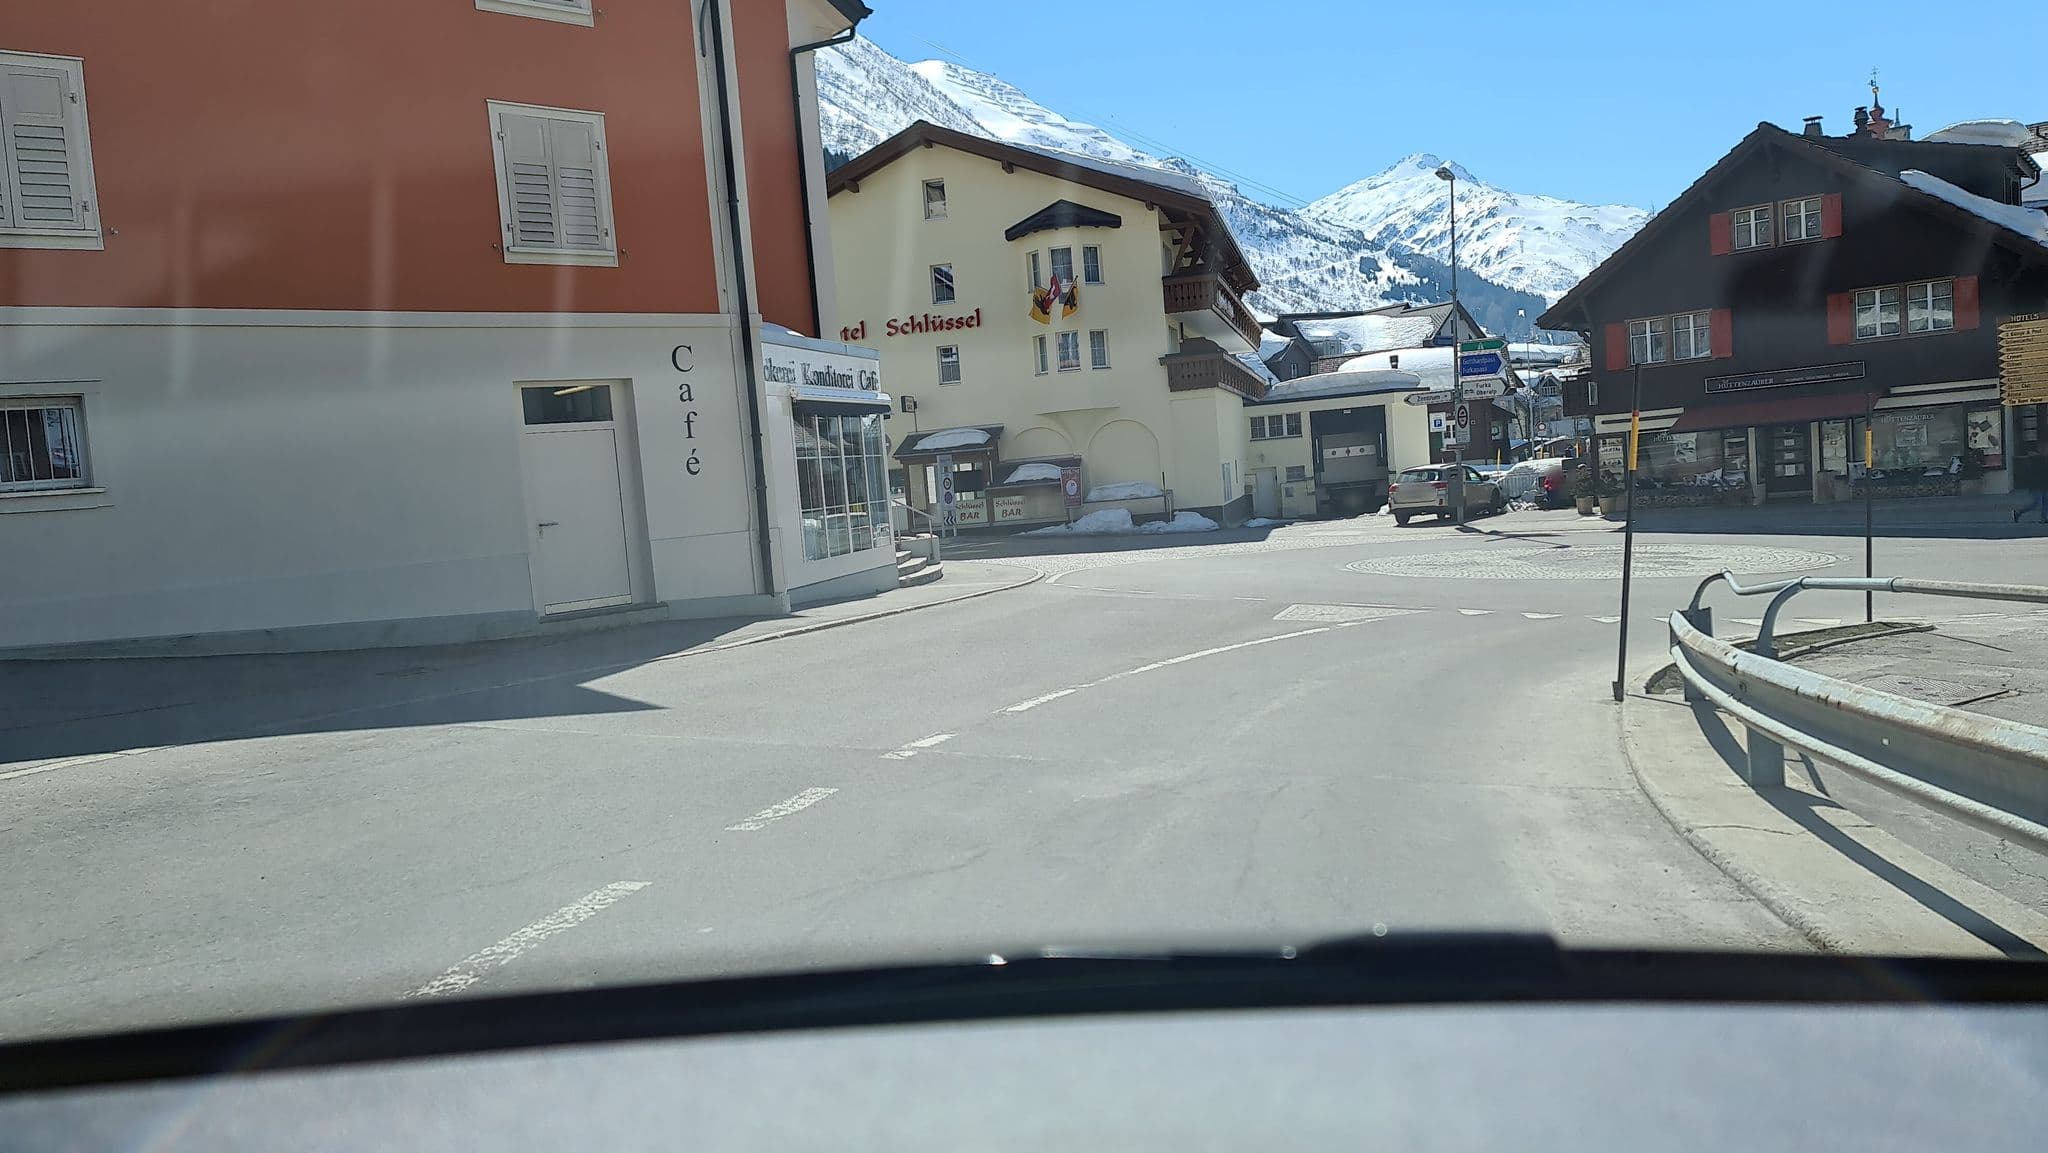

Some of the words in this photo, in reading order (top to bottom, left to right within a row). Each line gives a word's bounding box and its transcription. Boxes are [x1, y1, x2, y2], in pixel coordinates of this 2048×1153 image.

[840, 320, 867, 342] tel
[885, 307, 982, 338] Schlüssel
[800, 362, 855, 390] Konditorei
[1476, 388, 1497, 397] Oberalp
[1416, 394, 1441, 402] Zentrum
[671, 344, 701, 476] Café
[960, 511, 980, 521] BAR
[1001, 508, 1023, 518] BAR
